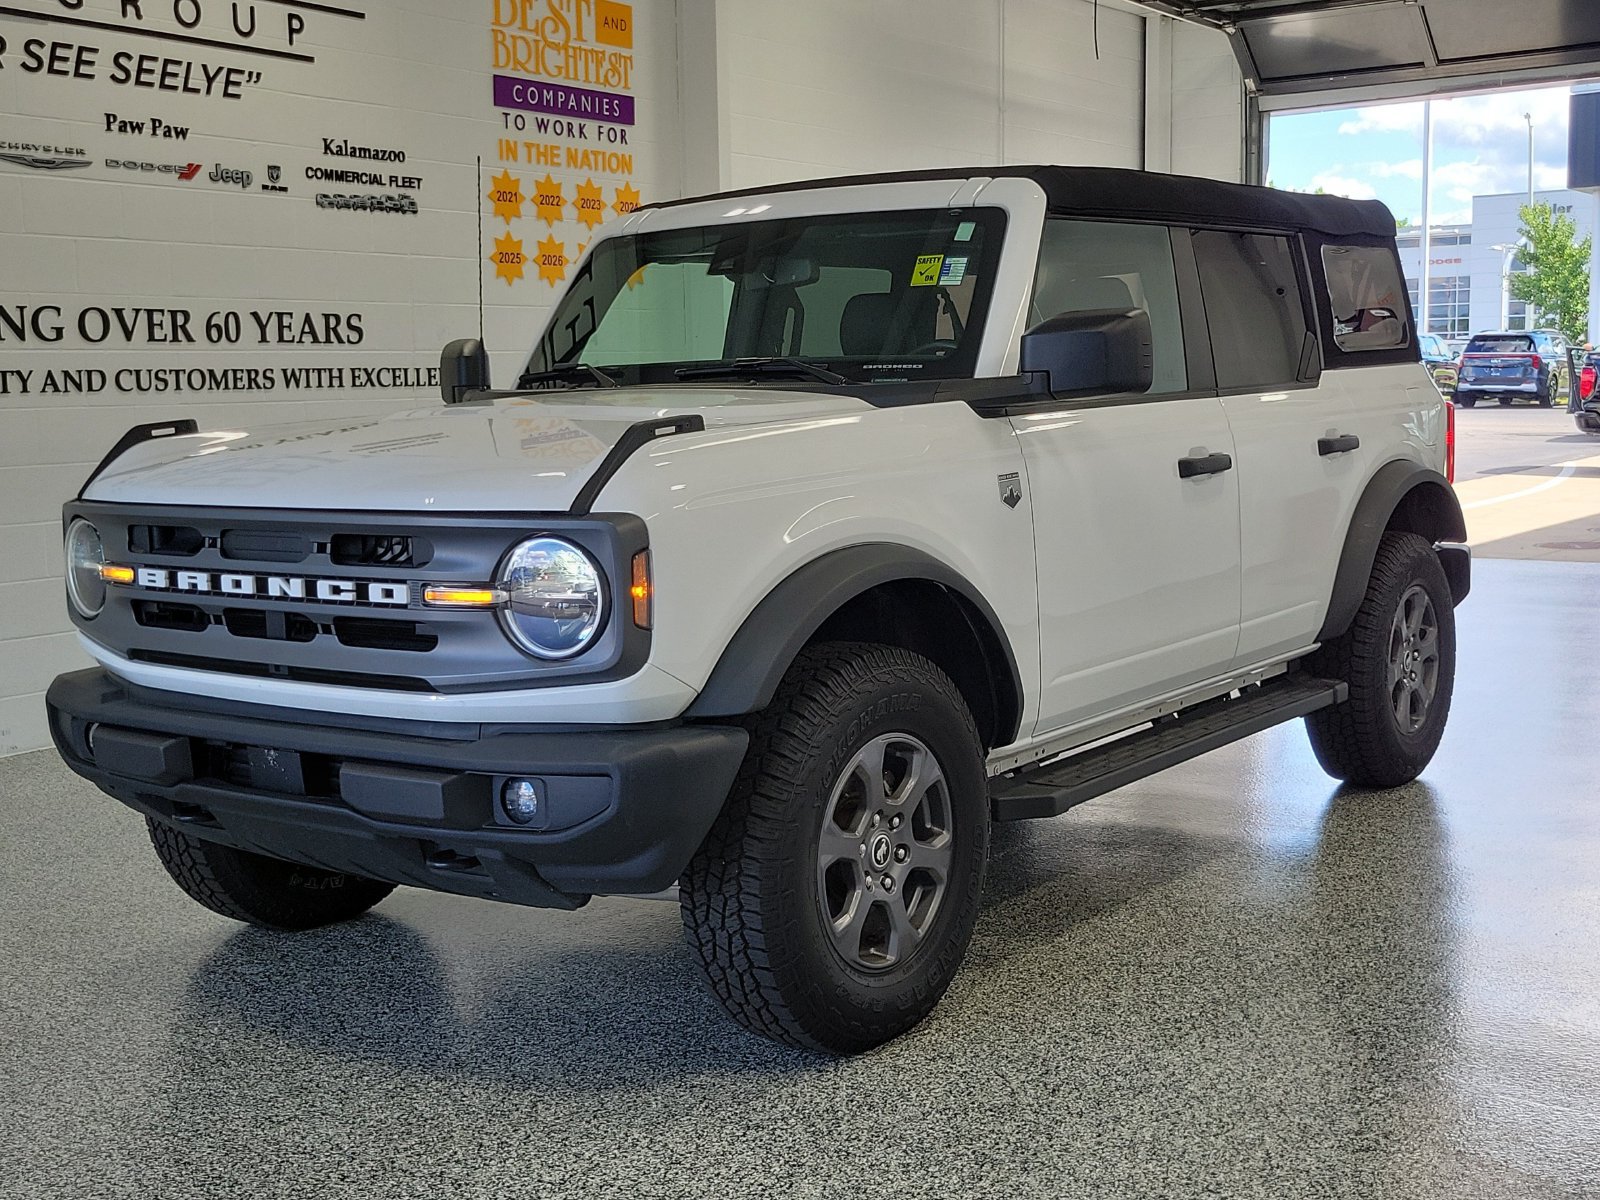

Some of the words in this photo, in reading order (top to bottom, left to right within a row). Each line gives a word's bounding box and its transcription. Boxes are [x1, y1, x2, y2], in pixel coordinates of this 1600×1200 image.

[603, 16, 627, 32] AND
[20, 38, 100, 80] SEE
[110, 51, 262, 100] SEELYE”
[491, 28, 634, 90] BRIGHTEST
[513, 85, 620, 117] COMPANIES
[104, 113, 145, 134] Paw
[150, 118, 190, 141] Paw
[502, 112, 526, 131] TO
[536, 117, 588, 139] WORK
[598, 126, 628, 145] FOR
[0, 141, 86, 156] CHRYSLER
[322, 138, 405, 163] Kalamazoo
[498, 139, 518, 162] IN
[524, 142, 561, 167] THE
[566, 147, 633, 175] NATION
[105, 159, 190, 174] DODGE
[209, 163, 253, 188] Jeep
[305, 167, 387, 186] COMMERCIAL
[389, 175, 423, 189] FLEET
[496, 190, 518, 203] 2021
[539, 194, 561, 207] 2022
[581, 198, 601, 210] 2023
[499, 252, 521, 264] 2025
[542, 255, 563, 267] 2026
[917, 257, 941, 265] SAFETY
[78, 306, 196, 343] OVER
[205, 311, 241, 344] 60
[250, 311, 364, 345] YEARS
[40, 369, 107, 393] AND
[115, 368, 276, 392] CUSTOMERS
[281, 367, 345, 389] WITH
[350, 367, 441, 387] EXCELLE
[138, 568, 410, 604] BRONCO
